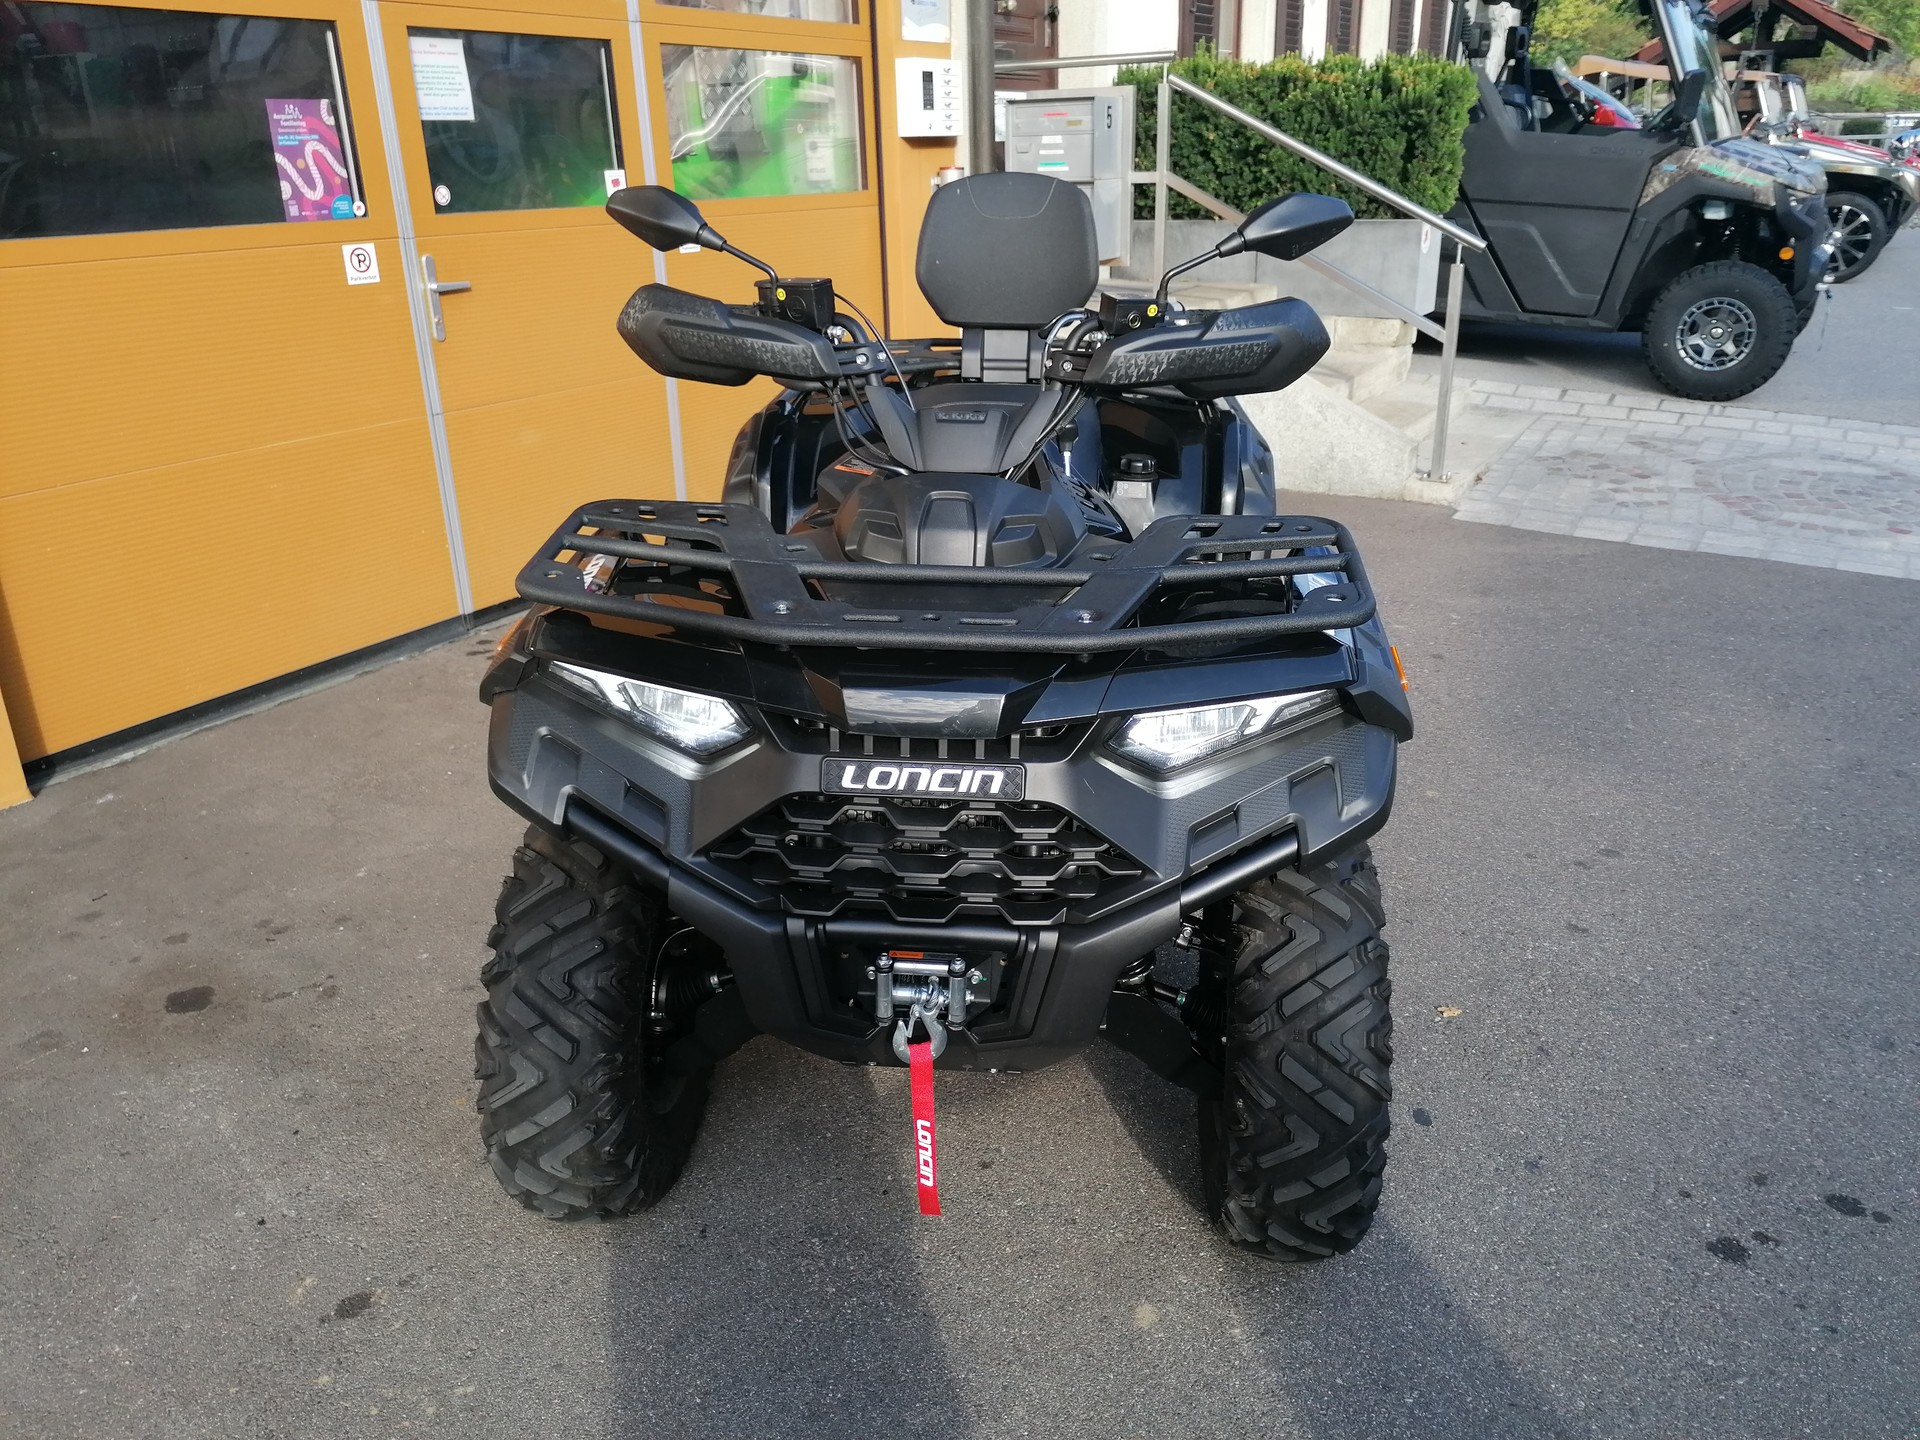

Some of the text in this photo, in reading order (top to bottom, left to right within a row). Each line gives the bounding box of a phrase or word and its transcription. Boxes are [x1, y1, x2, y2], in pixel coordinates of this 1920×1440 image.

[1106, 105, 1113, 129] 5
[841, 765, 1004, 794] LONCIN
[916, 1119, 934, 1187] LONCIN
